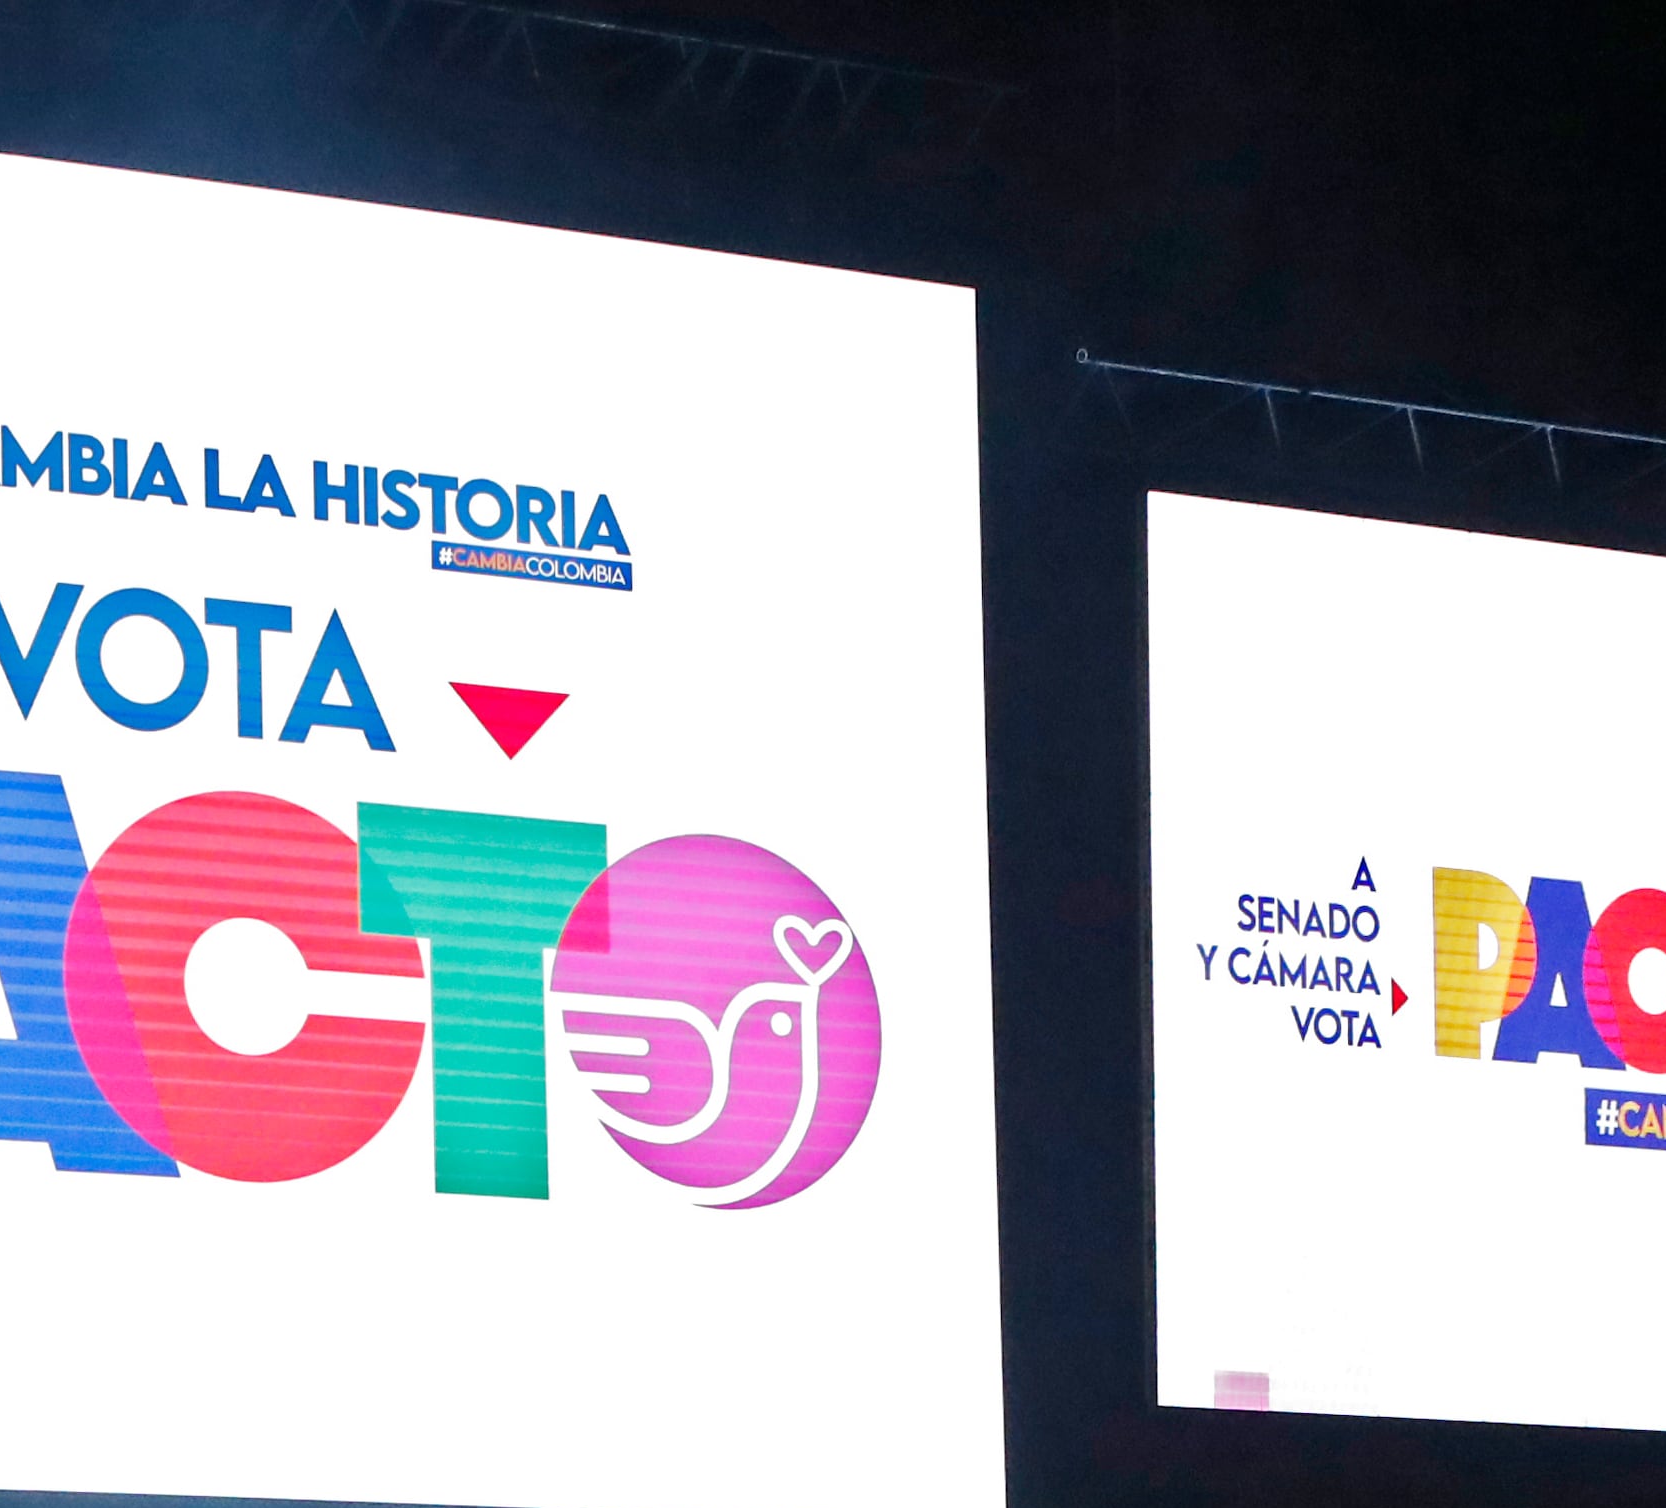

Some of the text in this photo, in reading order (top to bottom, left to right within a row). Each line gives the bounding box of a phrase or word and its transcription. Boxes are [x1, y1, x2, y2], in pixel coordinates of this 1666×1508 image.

[203, 447, 297, 518] LA
[312, 460, 632, 556] HISTORIA
[438, 546, 626, 585] #CAMBIACOLOMBIA
[1351, 855, 1377, 893] A
[1237, 893, 1381, 943] SENADO
[1196, 939, 1381, 996] Y CÁMARA
[1290, 1005, 1382, 1049] VOTA
